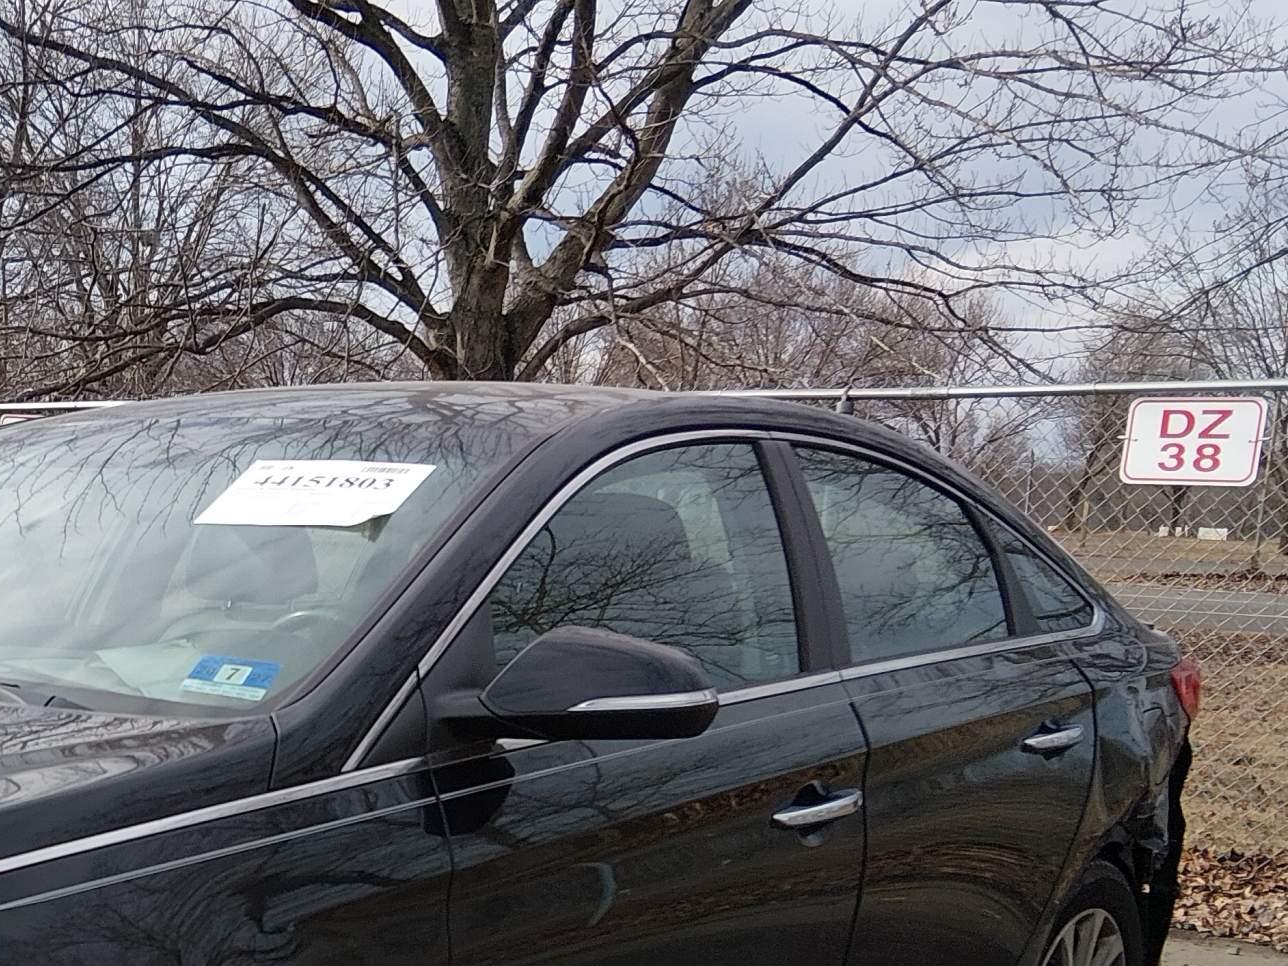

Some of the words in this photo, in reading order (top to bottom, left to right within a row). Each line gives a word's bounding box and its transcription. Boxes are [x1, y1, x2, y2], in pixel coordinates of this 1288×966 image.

[1159, 409, 1234, 439] DZ
[1157, 443, 1222, 472] 38
[252, 474, 395, 490] 44151803
[225, 667, 241, 681] 7
